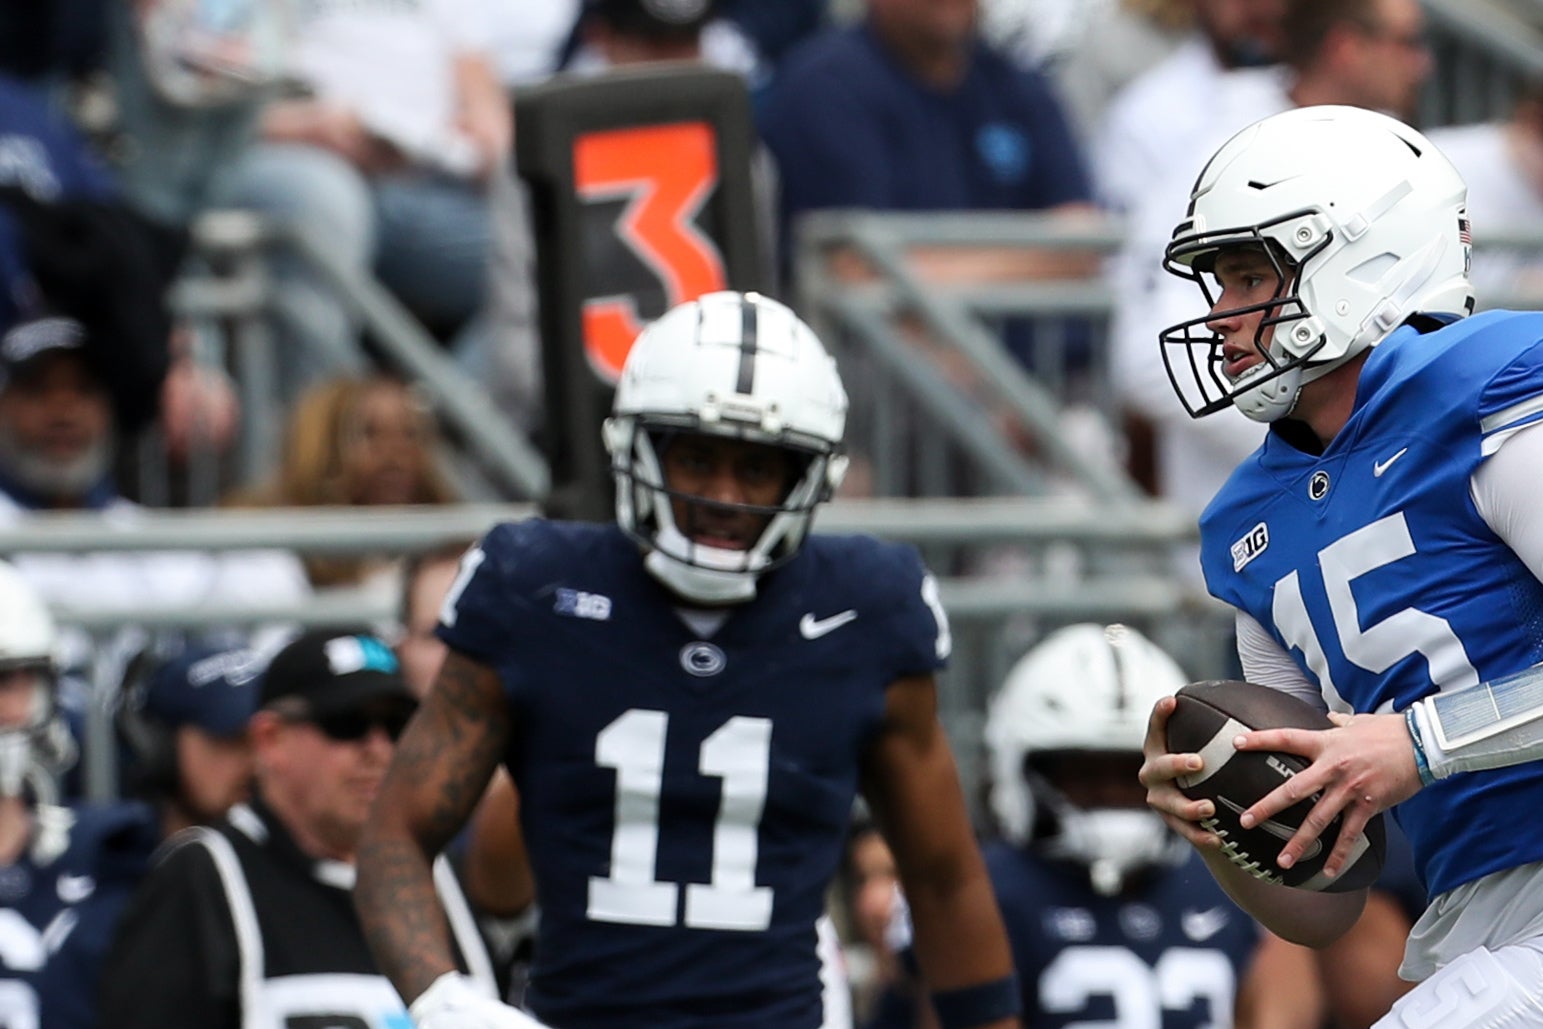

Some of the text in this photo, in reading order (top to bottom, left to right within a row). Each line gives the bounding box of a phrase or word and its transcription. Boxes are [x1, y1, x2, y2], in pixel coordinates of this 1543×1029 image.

[573, 120, 729, 386] 3
[1272, 511, 1480, 715] 15
[586, 708, 774, 931] 11
